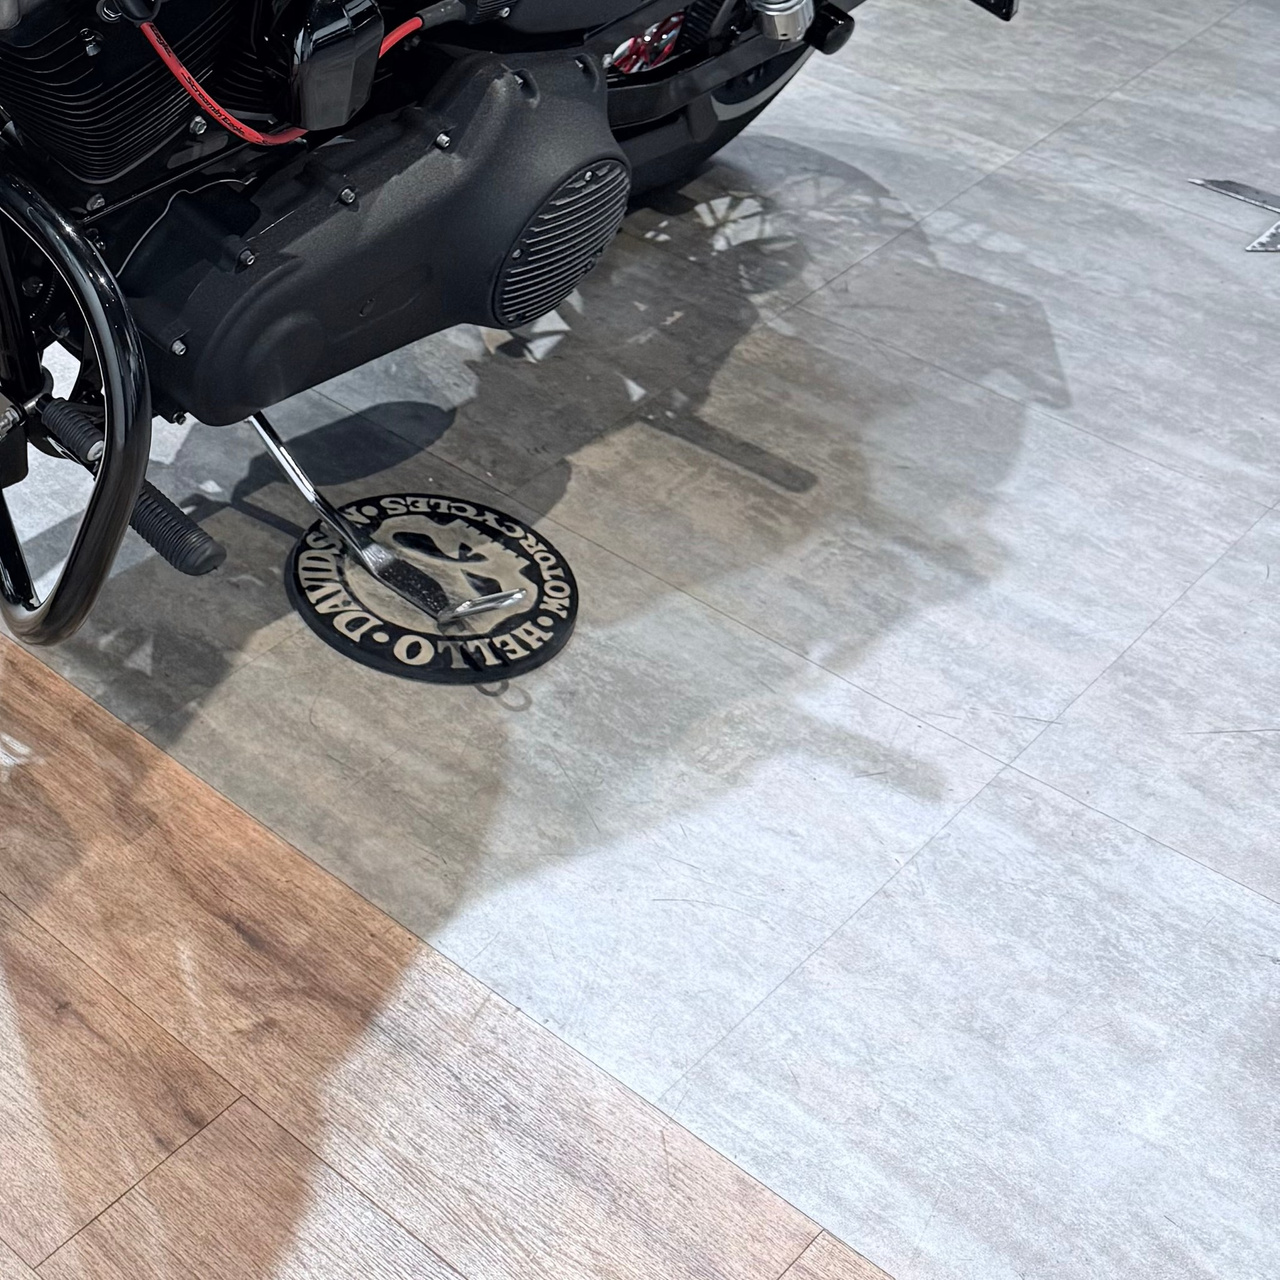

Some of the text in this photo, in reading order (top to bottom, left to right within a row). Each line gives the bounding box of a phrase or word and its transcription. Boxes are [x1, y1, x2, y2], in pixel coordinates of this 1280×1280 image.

[298, 506, 555, 669] HELLO DAVIDSN
[380, 496, 571, 618] MOTORCYCLES
